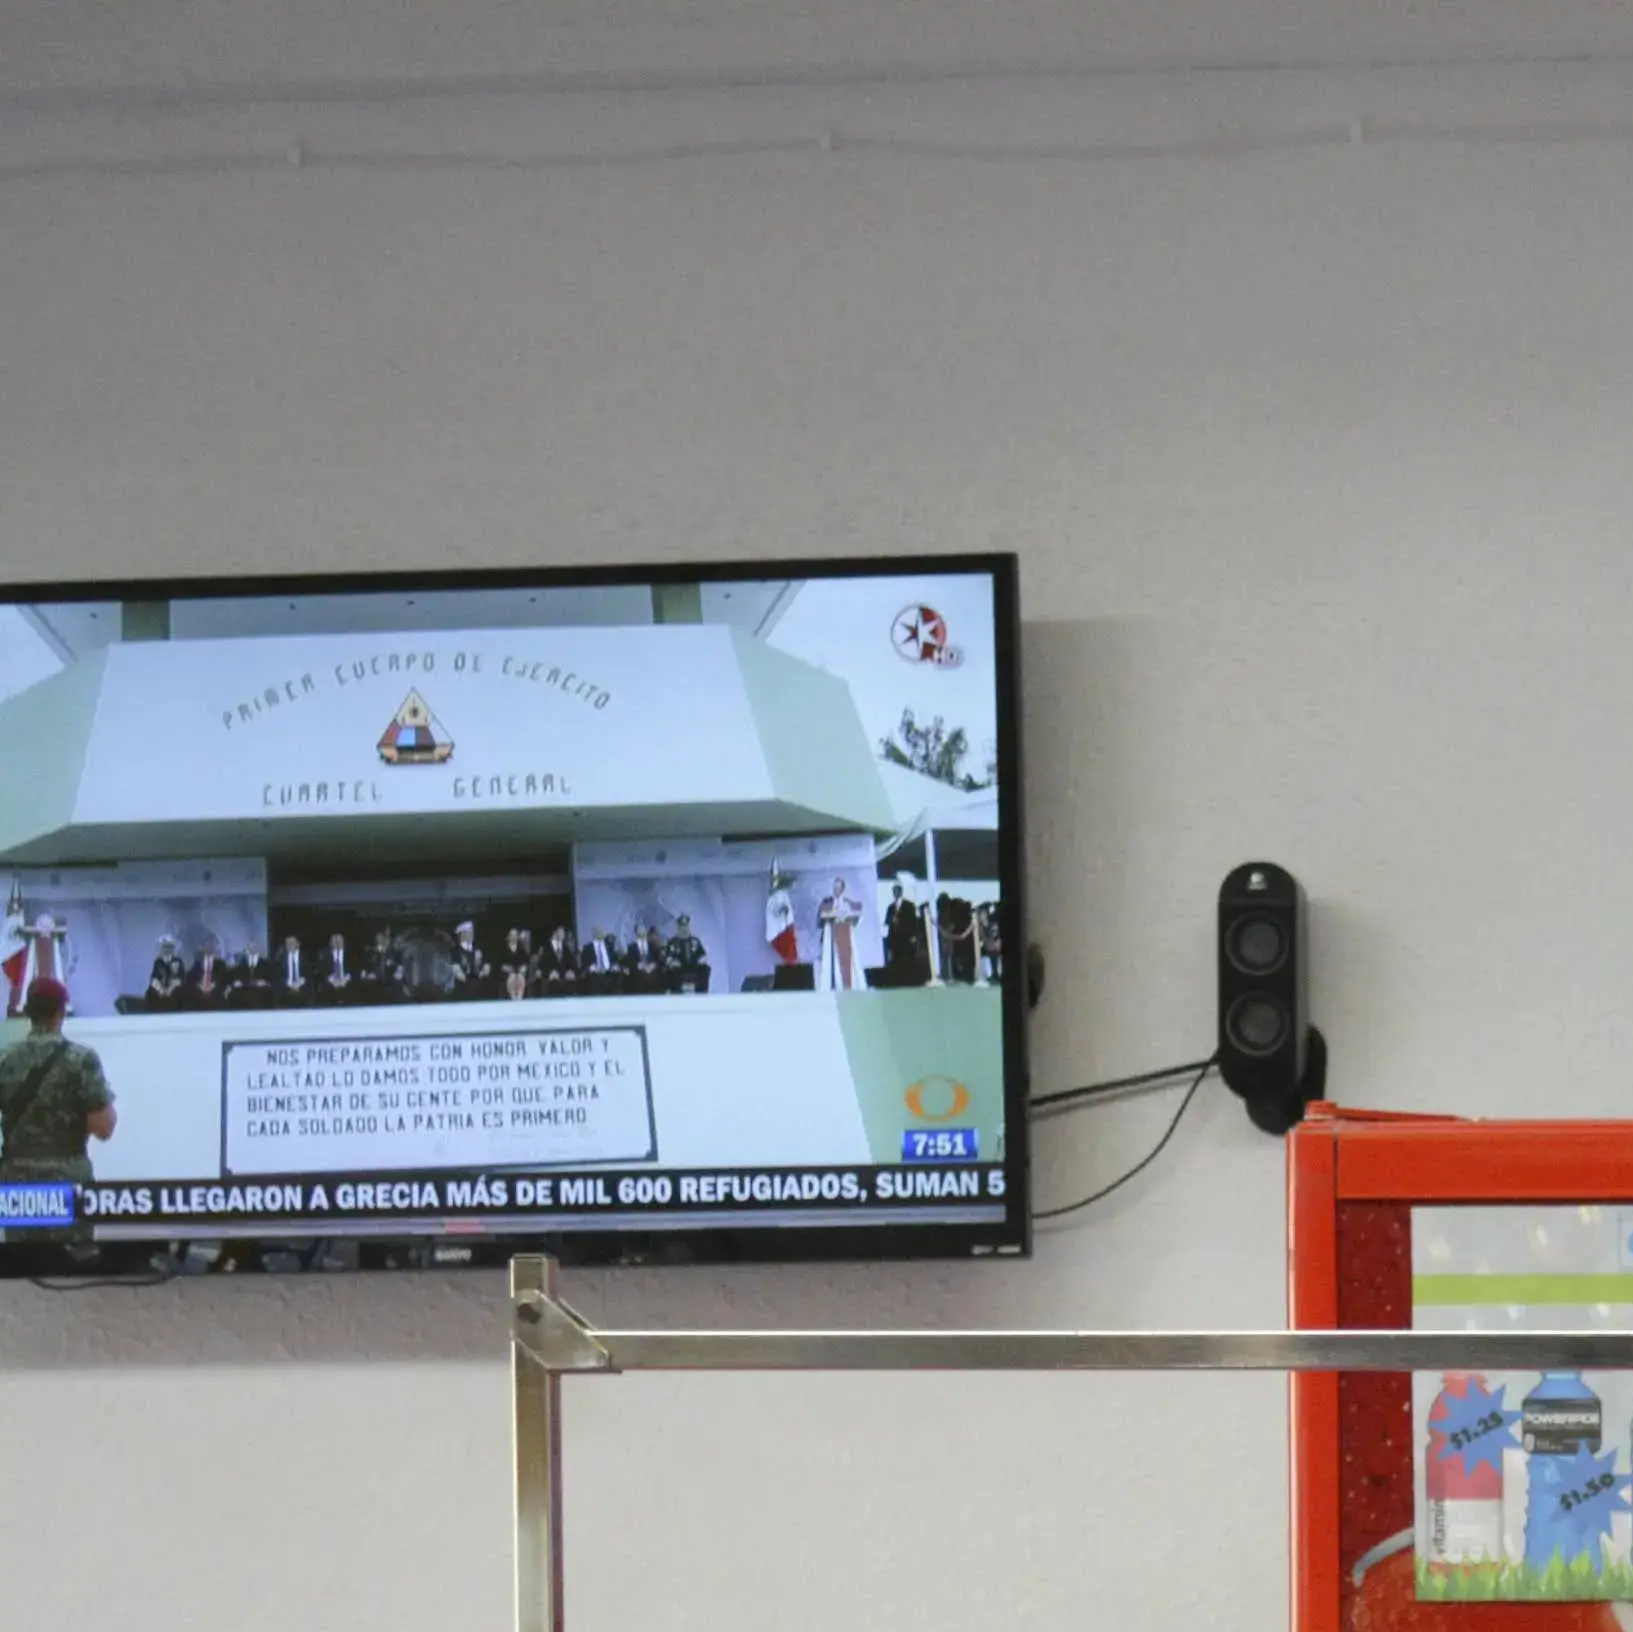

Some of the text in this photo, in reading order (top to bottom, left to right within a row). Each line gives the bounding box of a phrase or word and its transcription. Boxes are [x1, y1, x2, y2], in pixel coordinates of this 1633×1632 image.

[455, 653, 482, 673] DE
[453, 774, 571, 798] GENERAL
[267, 1038, 610, 1065] NOS PREPARAMOS CON HONOR VALOR Y
[247, 1072, 325, 1090] LEALTAD
[333, 1070, 353, 1086] LO
[361, 1068, 419, 1085] DAMOS
[427, 1066, 470, 1083] TODO
[478, 1064, 511, 1081] POR
[588, 1060, 597, 1076] Y
[605, 1060, 624, 1076] EL
[247, 1084, 599, 1114] BIENESTAR DE SU GENTE POR QUE PARA
[247, 1108, 587, 1137] CADA SOLDADO LA PATRIA ES PRIMERO
[912, 1133, 968, 1157] 7:51
[160, 1187, 304, 1214] LLEGARON
[309, 1187, 329, 1211] A
[336, 1182, 439, 1210] GRECIA
[447, 1174, 507, 1207] MÁS
[516, 1180, 552, 1206] DE
[559, 1179, 611, 1205] MIL
[618, 1178, 671, 1204] 600
[680, 1173, 868, 1203] REFUGIADOS,
[876, 1172, 978, 1198] SUMAN
[1449, 1410, 1504, 1450] $1.25
[1559, 1471, 1615, 1511] $1.50
